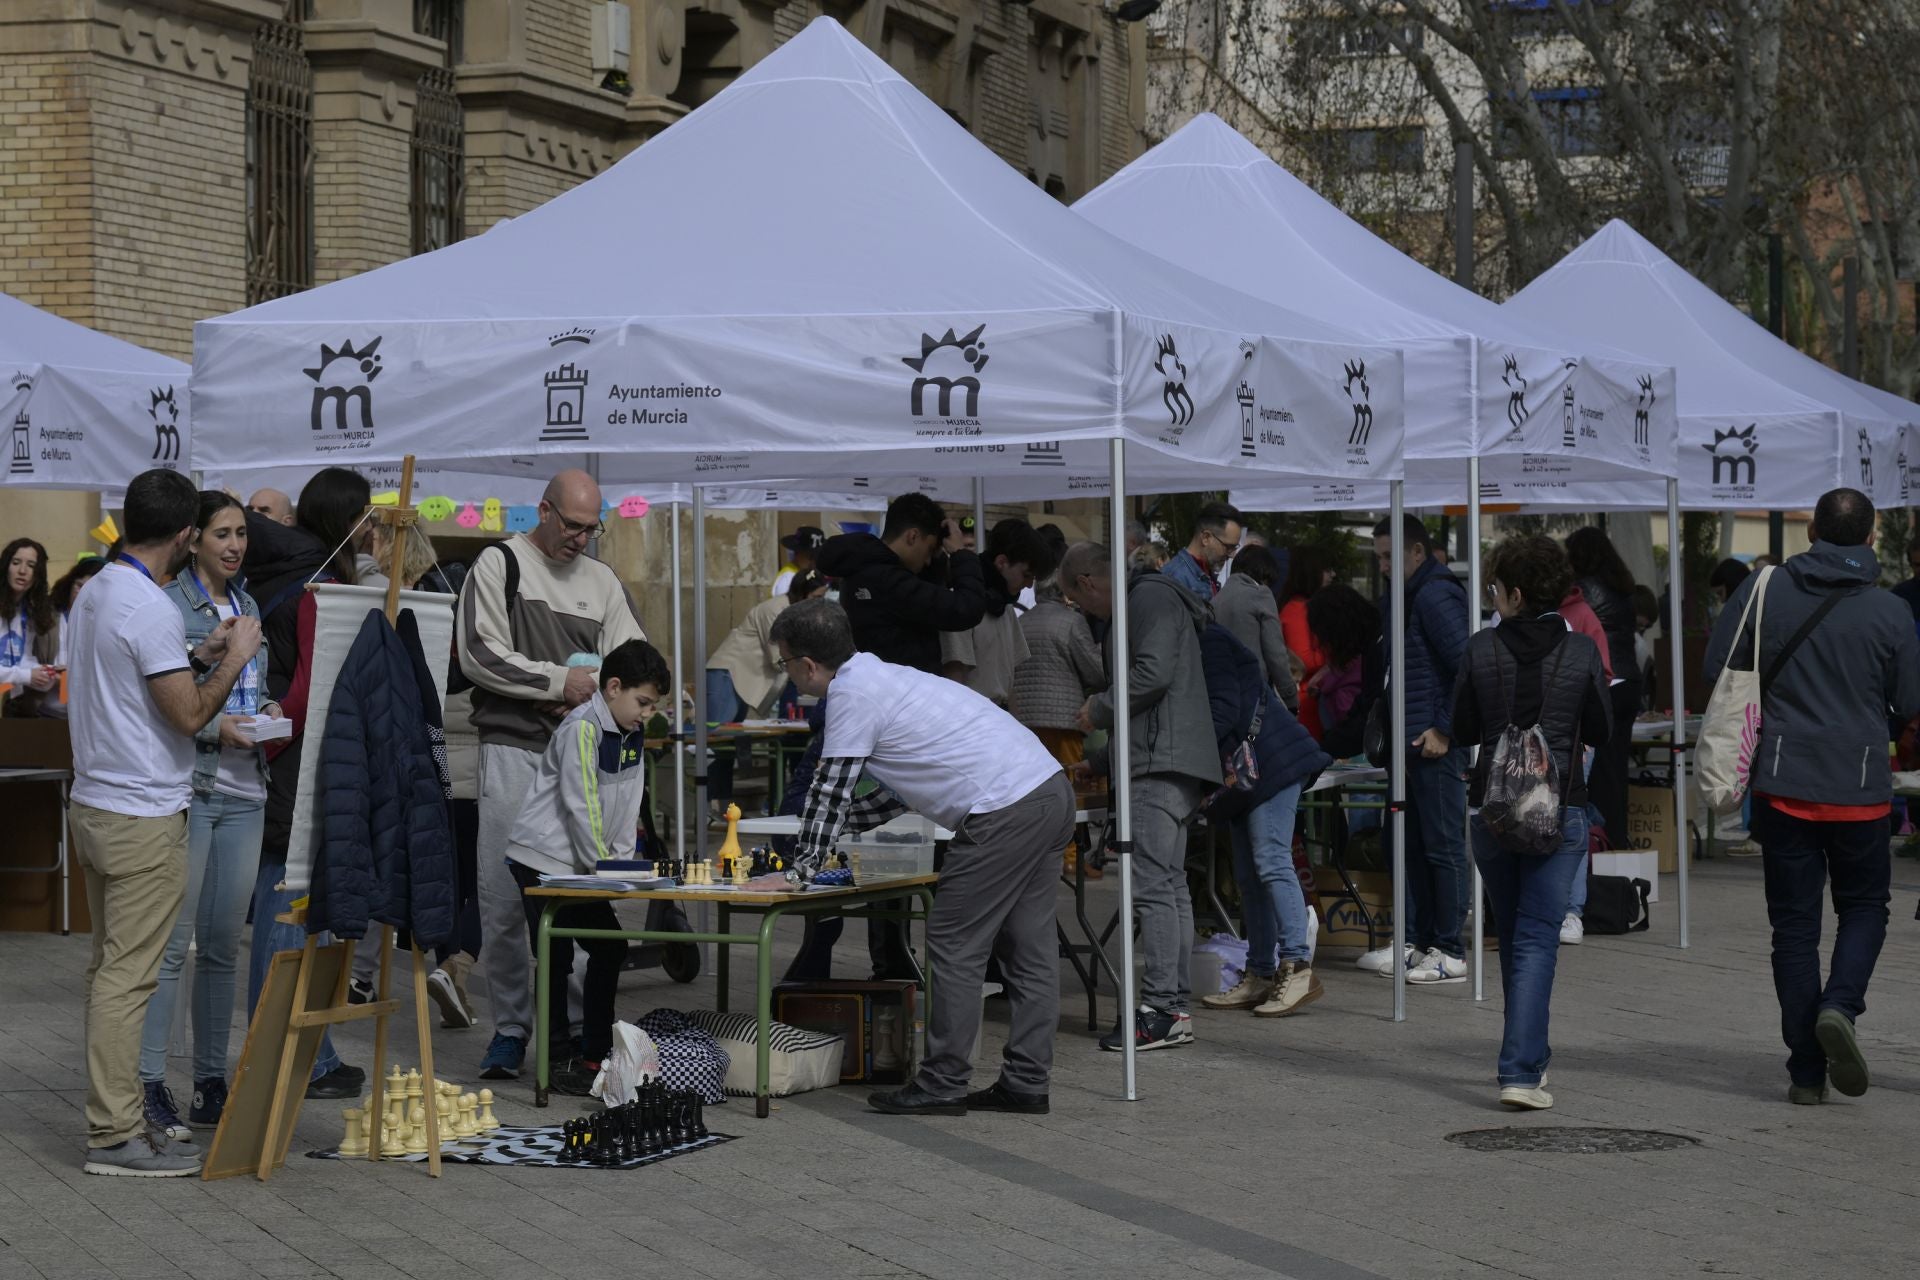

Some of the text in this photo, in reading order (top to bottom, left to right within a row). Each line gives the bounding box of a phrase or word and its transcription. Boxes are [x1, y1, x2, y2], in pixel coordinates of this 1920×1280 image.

[608, 382, 722, 402] Ayuntamiento
[607, 408, 688, 424] de Murcia
[343, 431, 375, 440] MURCIA
[965, 427, 983, 437] lado
[369, 465, 440, 474] Ayuntaiento
[1627, 803, 1662, 816] CAJA
[1629, 820, 1663, 832] IENE
